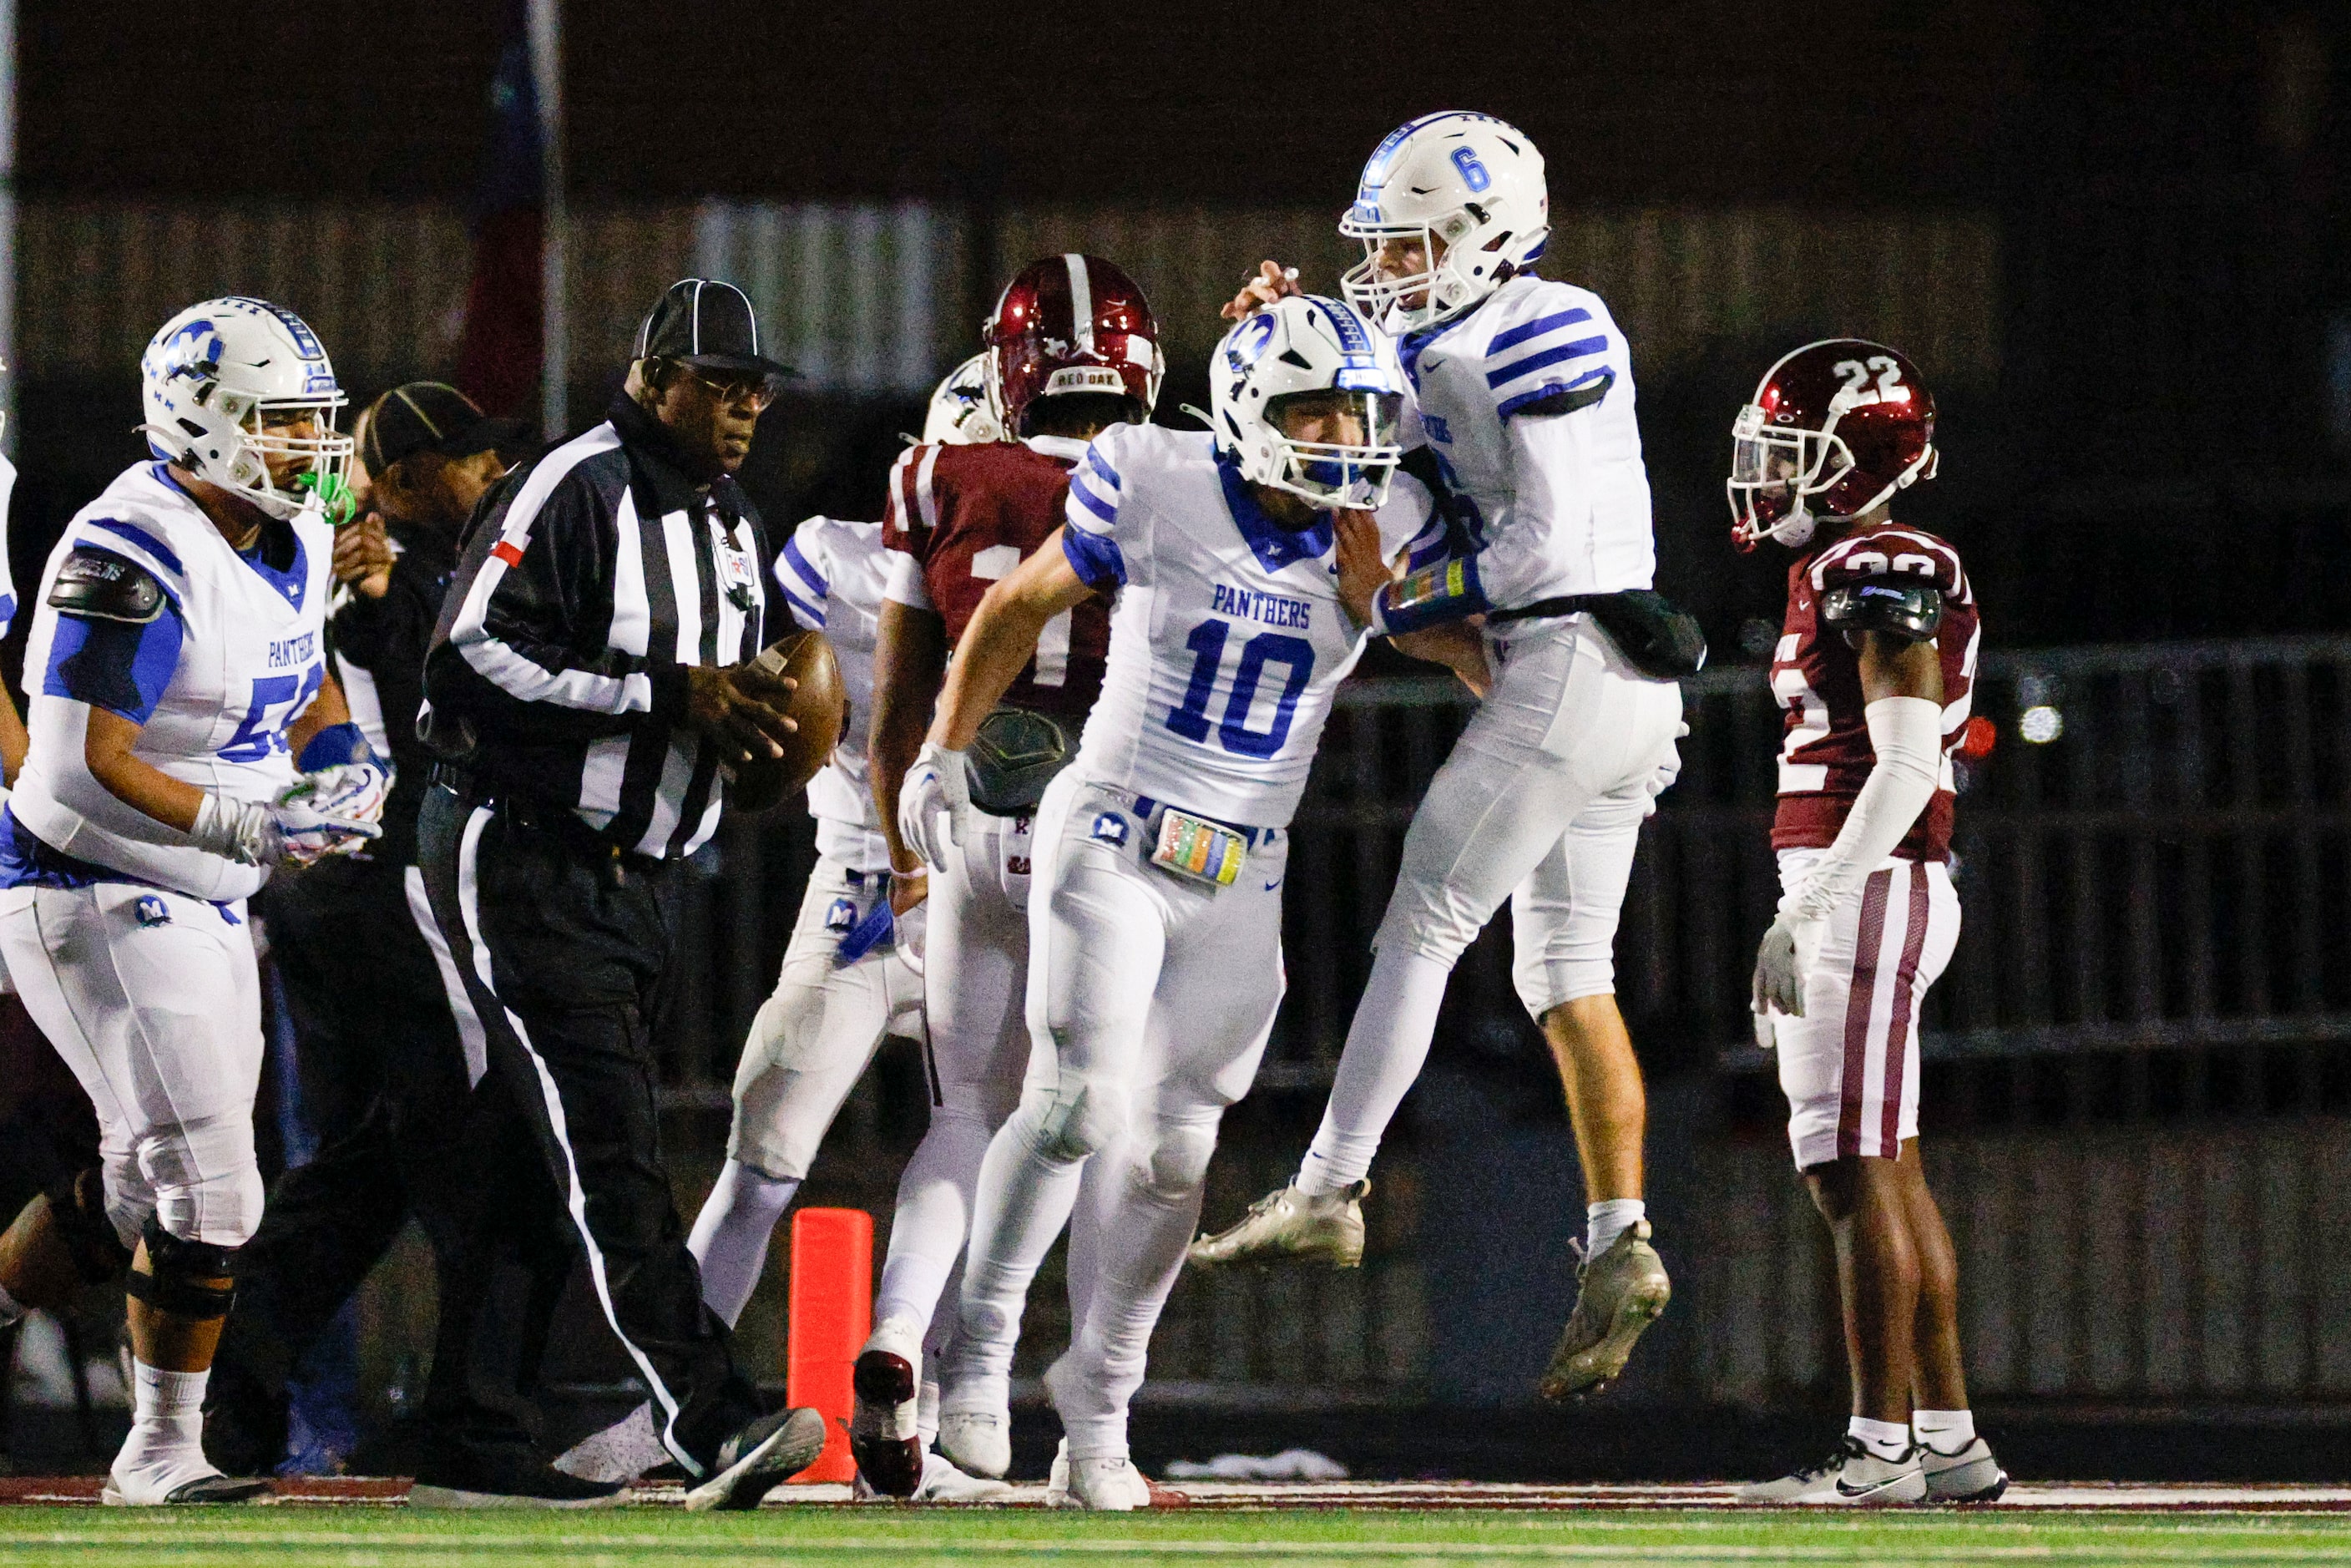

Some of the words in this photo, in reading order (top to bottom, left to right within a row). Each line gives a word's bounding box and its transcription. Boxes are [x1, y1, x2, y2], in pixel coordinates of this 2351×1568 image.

[1451, 145, 1491, 193] 6
[1059, 372, 1083, 385] RED
[1089, 374, 1115, 384] OAK
[1833, 356, 1911, 409] 22
[1211, 584, 1311, 629] PANTHERS
[1165, 618, 1316, 760] 10
